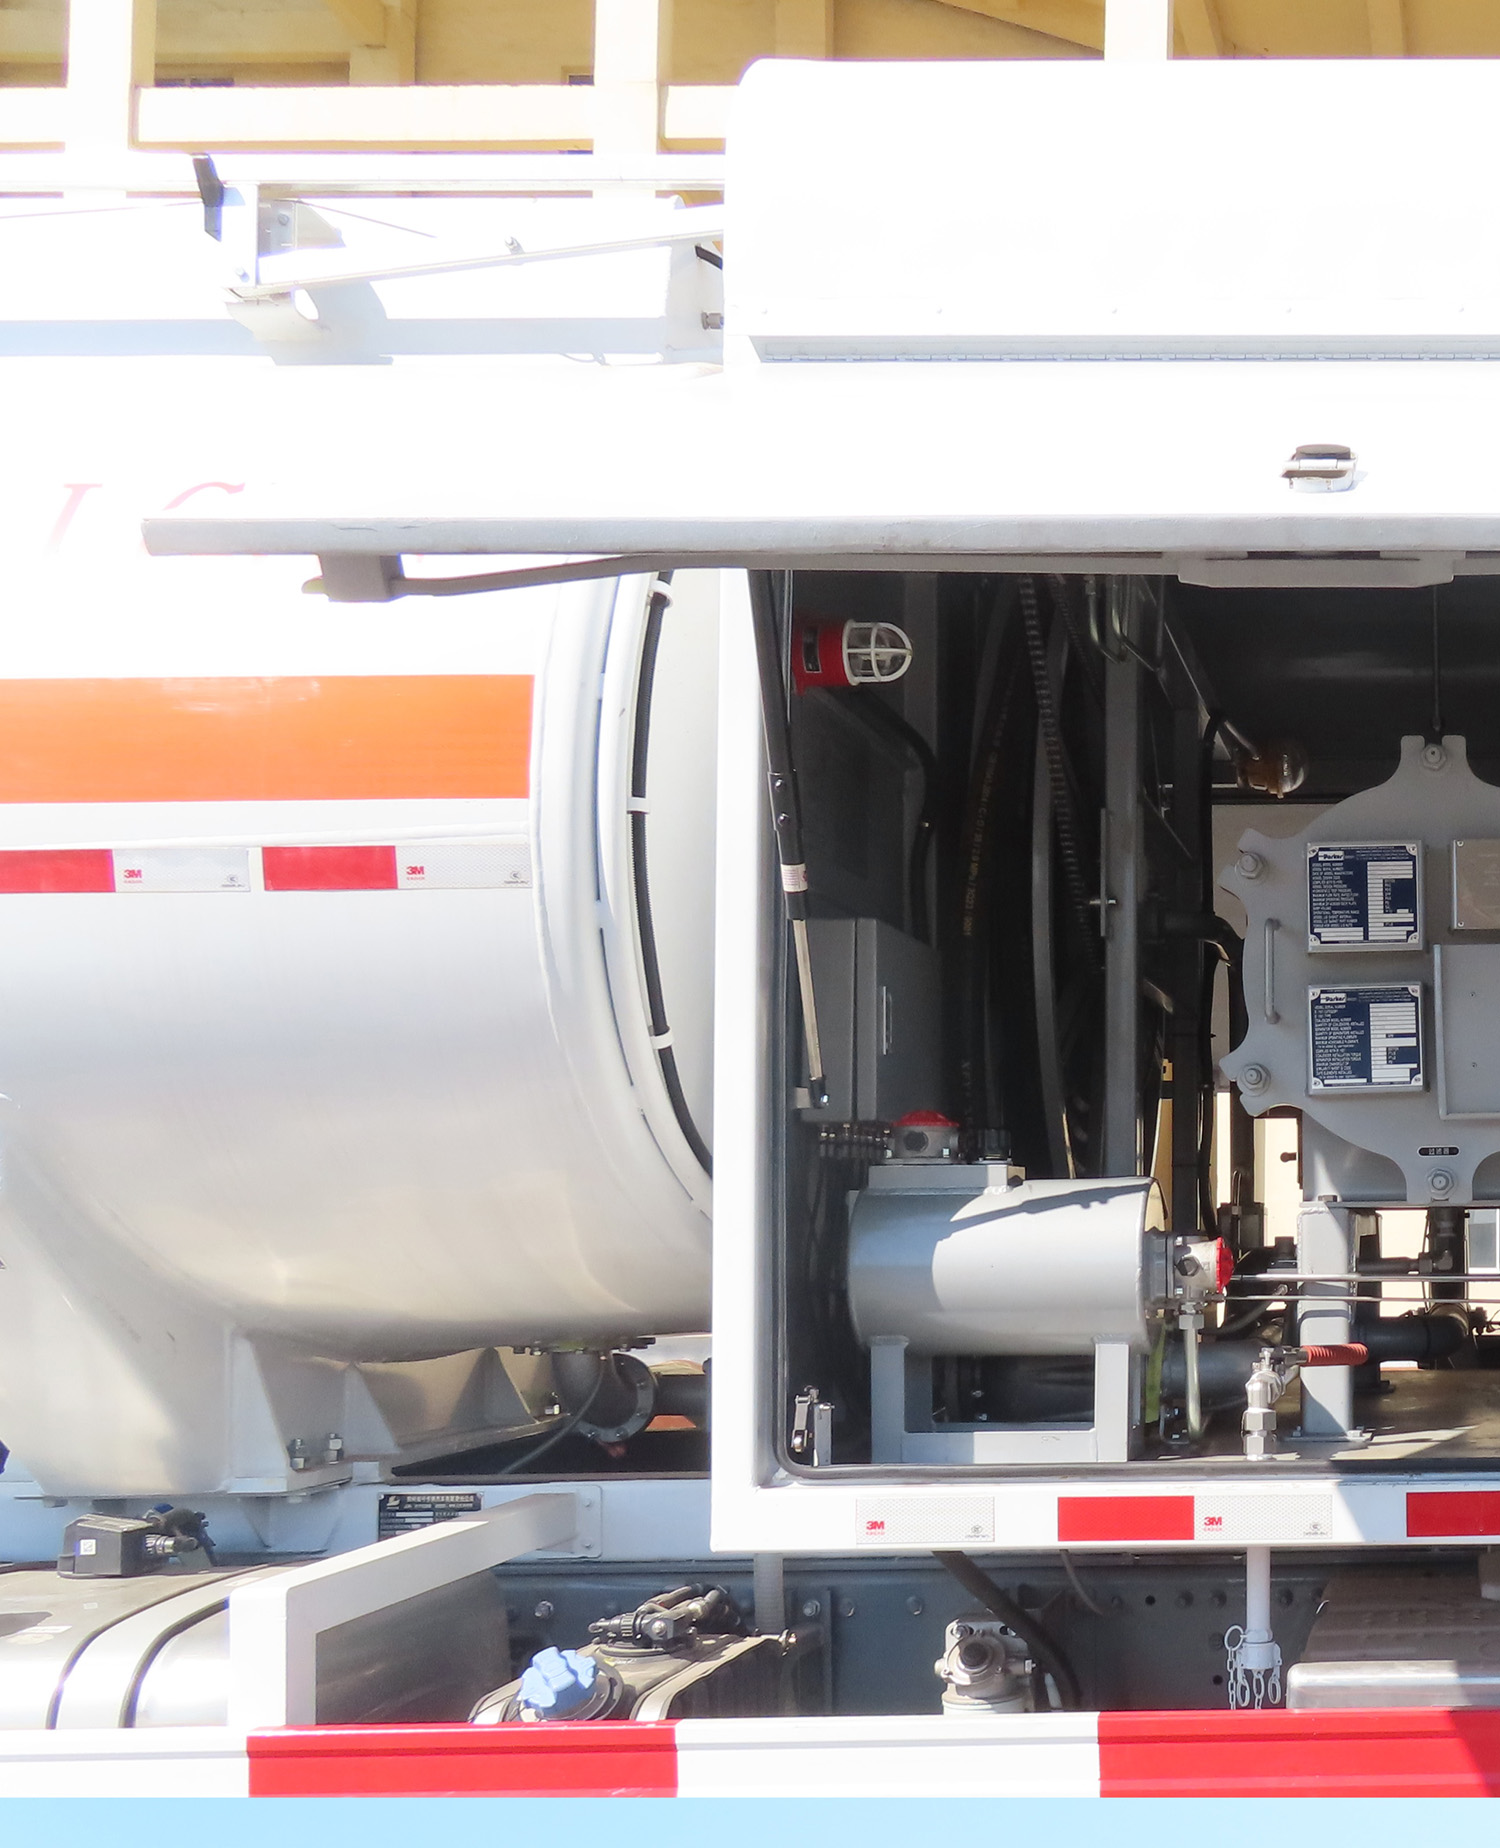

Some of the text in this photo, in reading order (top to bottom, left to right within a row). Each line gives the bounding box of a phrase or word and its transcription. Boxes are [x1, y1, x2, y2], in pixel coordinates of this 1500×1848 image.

[125, 869, 142, 879] 3M
[406, 866, 424, 876] 3M
[866, 1520, 884, 1530] 3M
[1204, 1516, 1222, 1526] 3M
